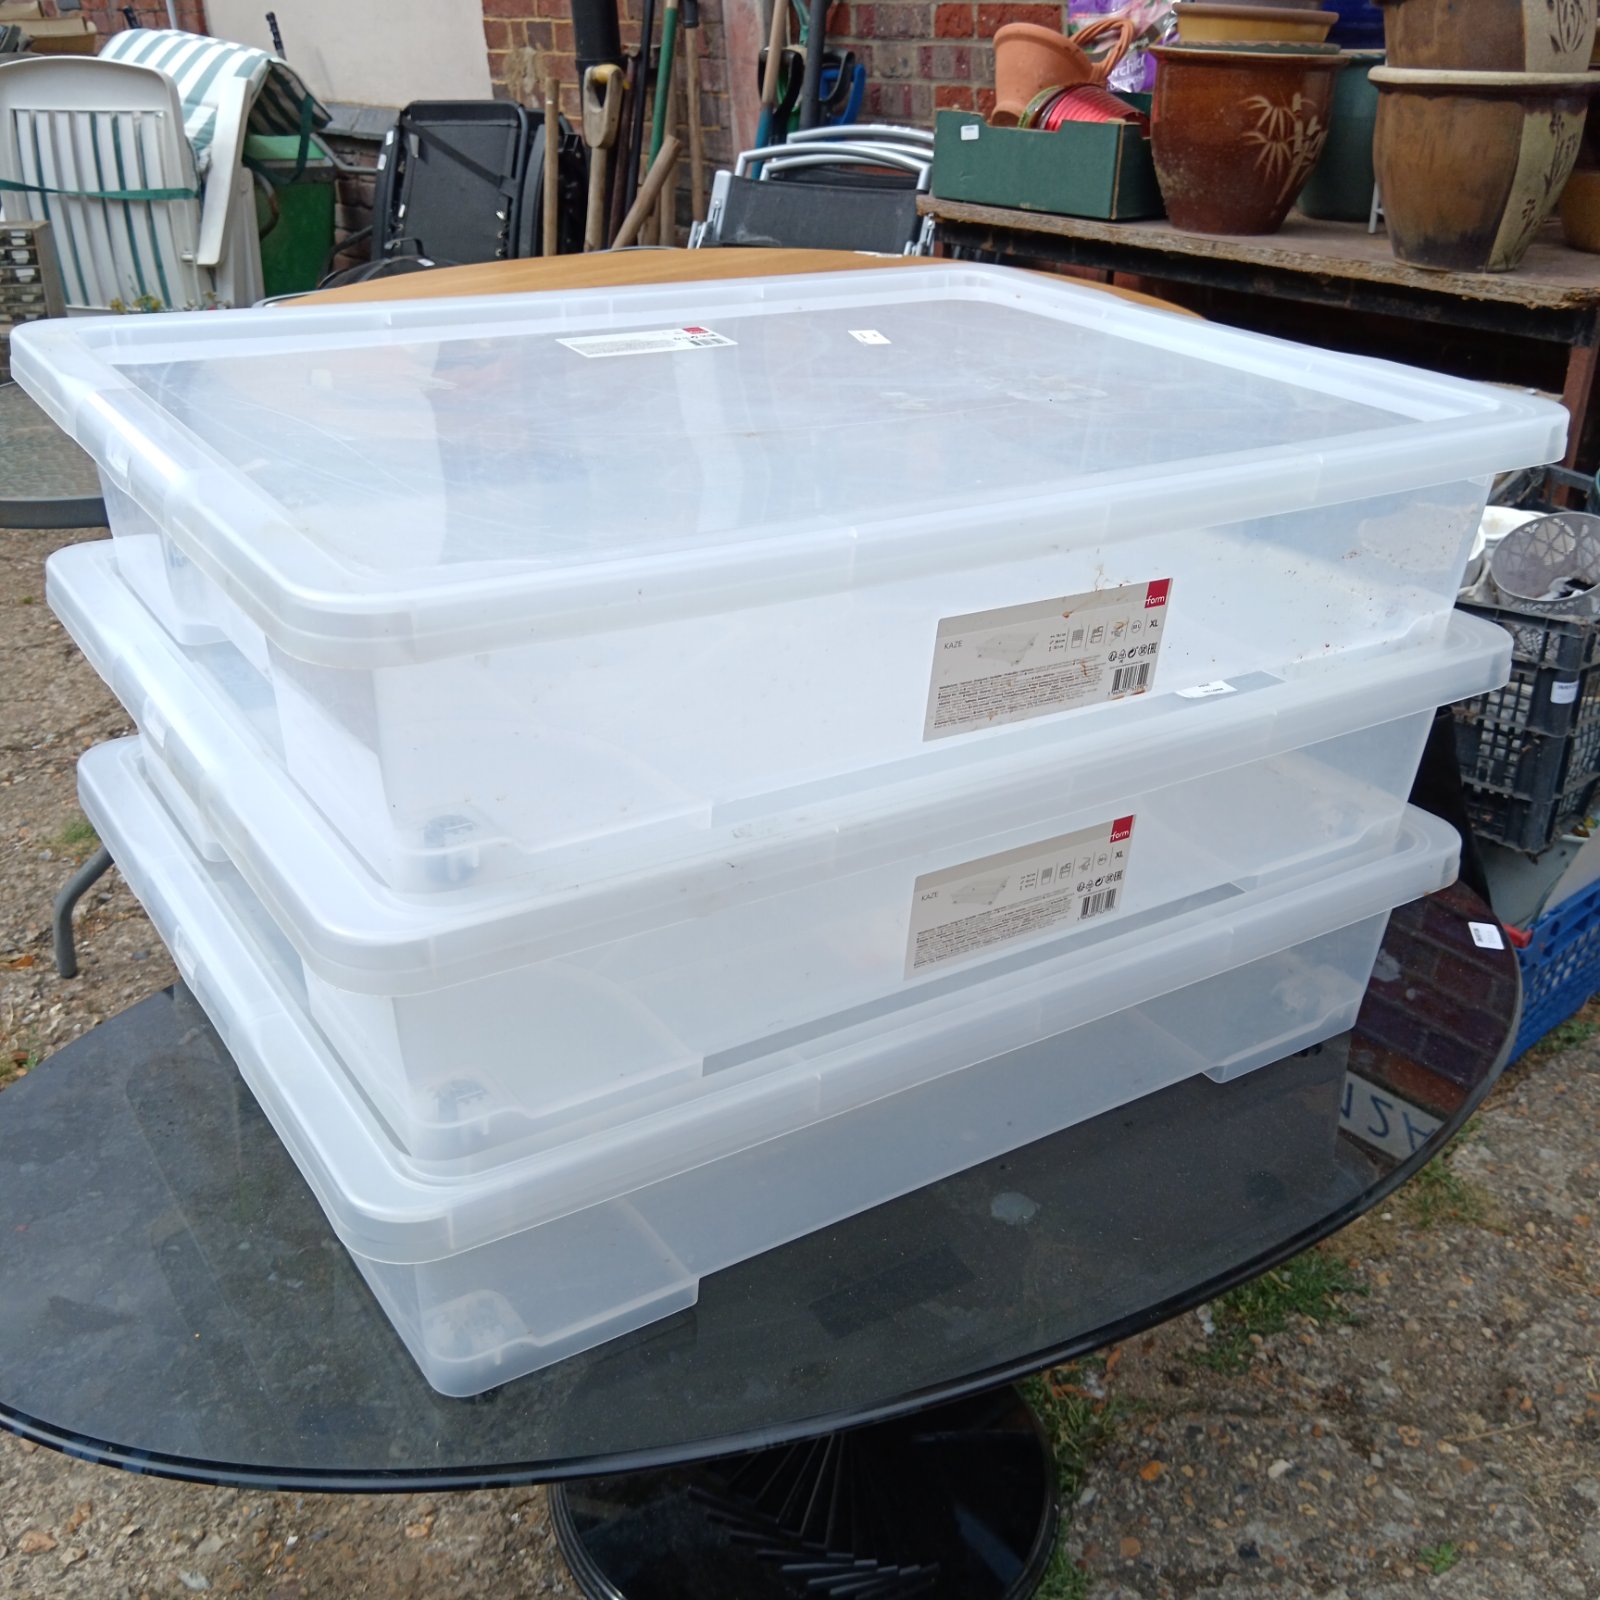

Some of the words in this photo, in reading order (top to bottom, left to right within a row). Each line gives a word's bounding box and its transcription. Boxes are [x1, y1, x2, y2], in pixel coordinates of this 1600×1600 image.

[1145, 595, 1165, 606] form
[1149, 619, 1159, 629] XL
[944, 640, 963, 650] KAZE
[1110, 830, 1129, 841] form
[1115, 850, 1124, 859] XL
